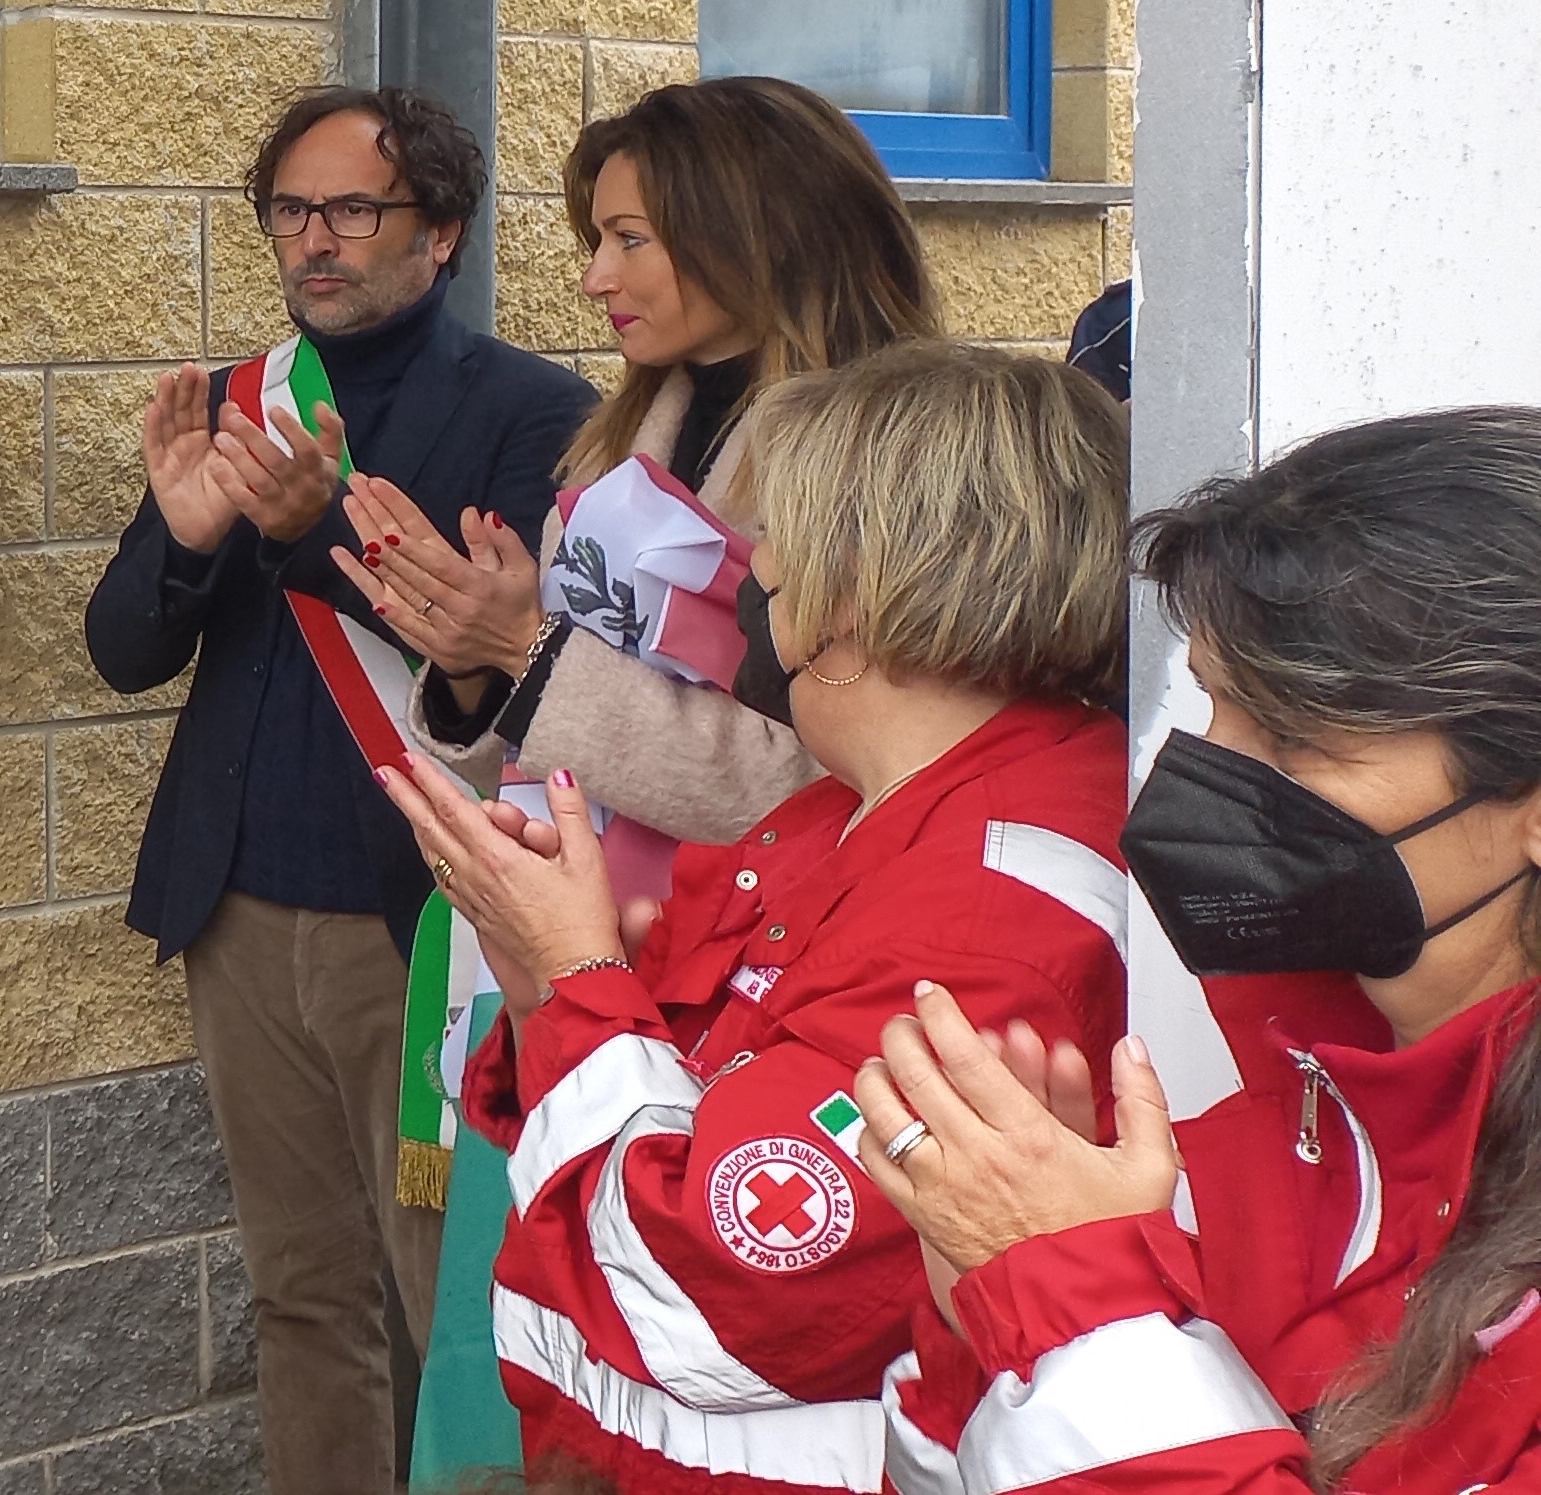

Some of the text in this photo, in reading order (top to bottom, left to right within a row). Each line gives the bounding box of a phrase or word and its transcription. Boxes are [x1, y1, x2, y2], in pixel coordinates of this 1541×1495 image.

[713, 1142, 850, 1269] CONVENZIONE DI GINEVRA 22 AGOSTO 1864
